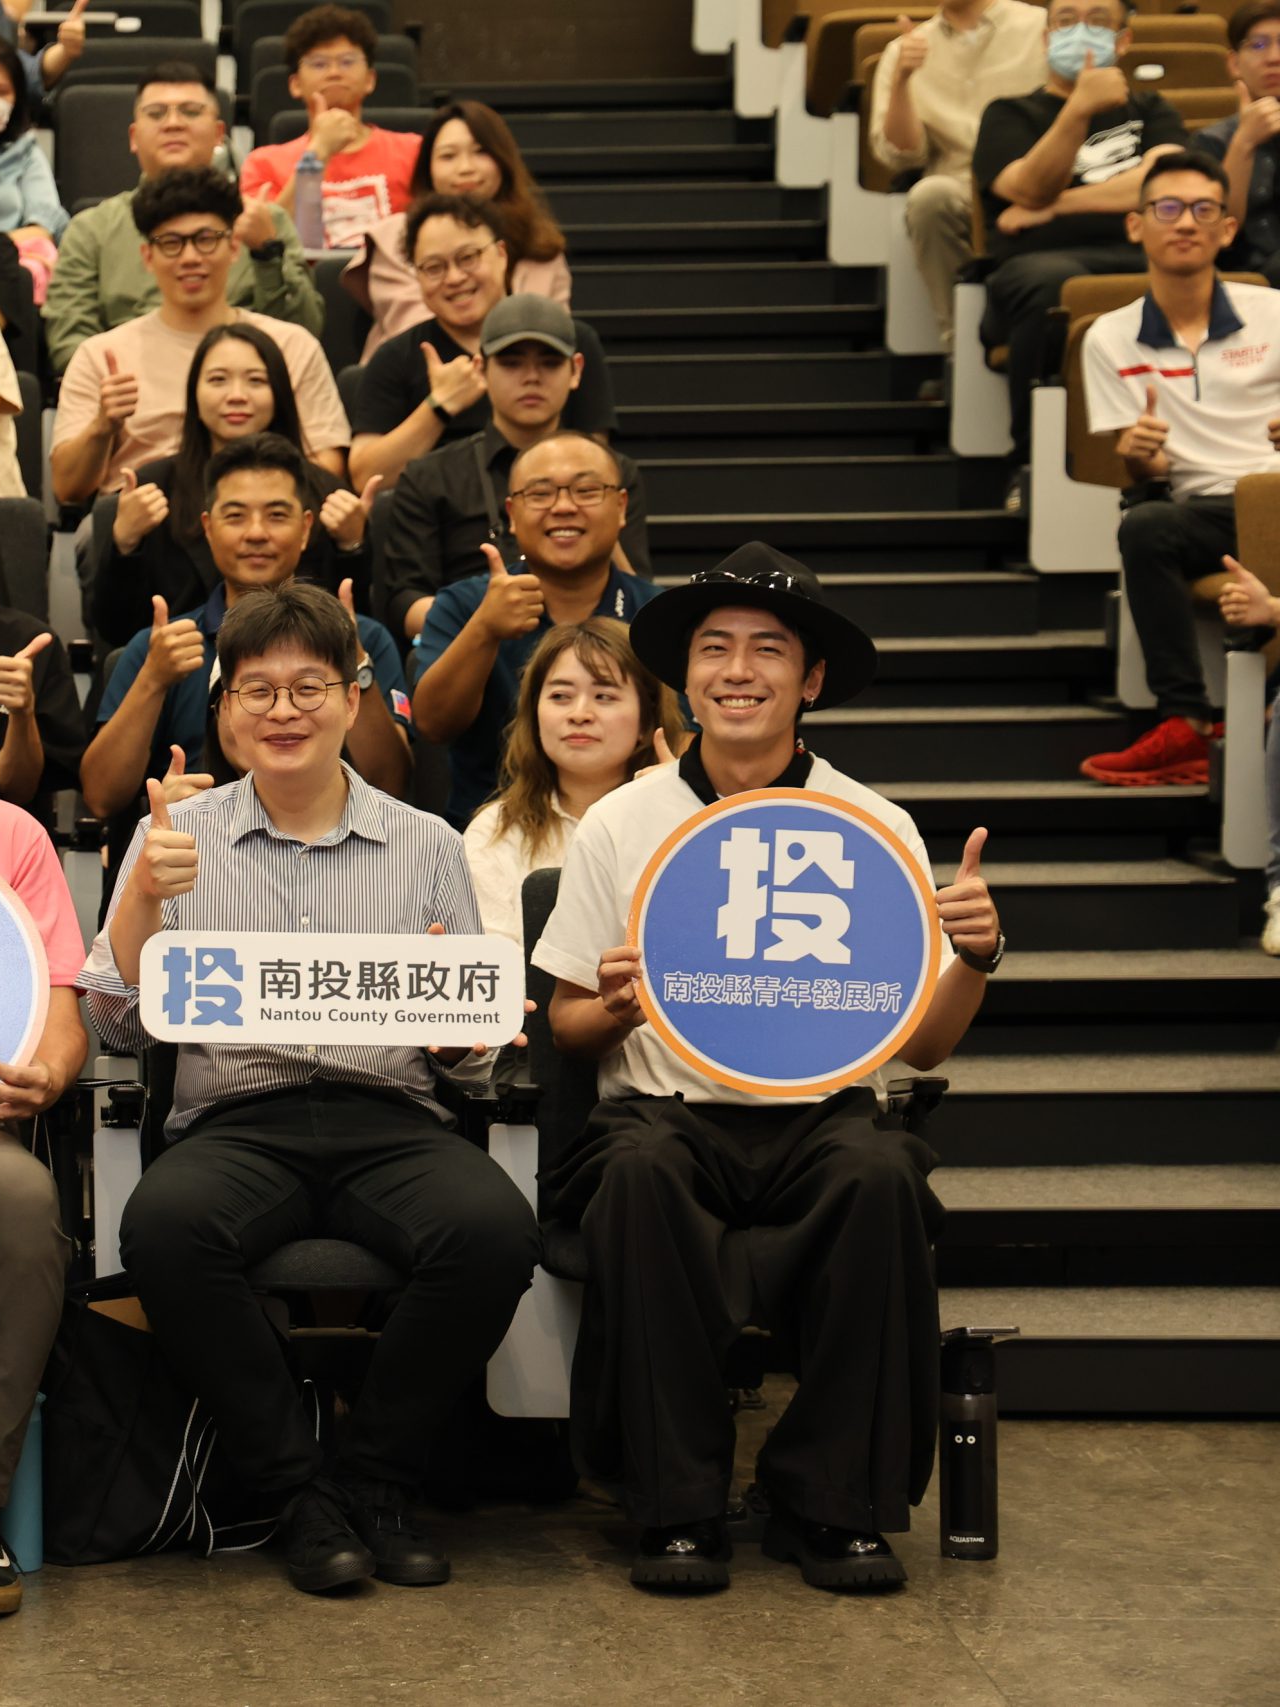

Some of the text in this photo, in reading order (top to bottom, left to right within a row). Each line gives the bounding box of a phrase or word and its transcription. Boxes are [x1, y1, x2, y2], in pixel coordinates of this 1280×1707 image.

[717, 827, 855, 965] 投
[162, 946, 244, 1026] 投
[259, 958, 501, 1003] 南投縣政府
[664, 971, 902, 1013] 南投縣青年發展所
[260, 1007, 501, 1026] Nantou County Government
